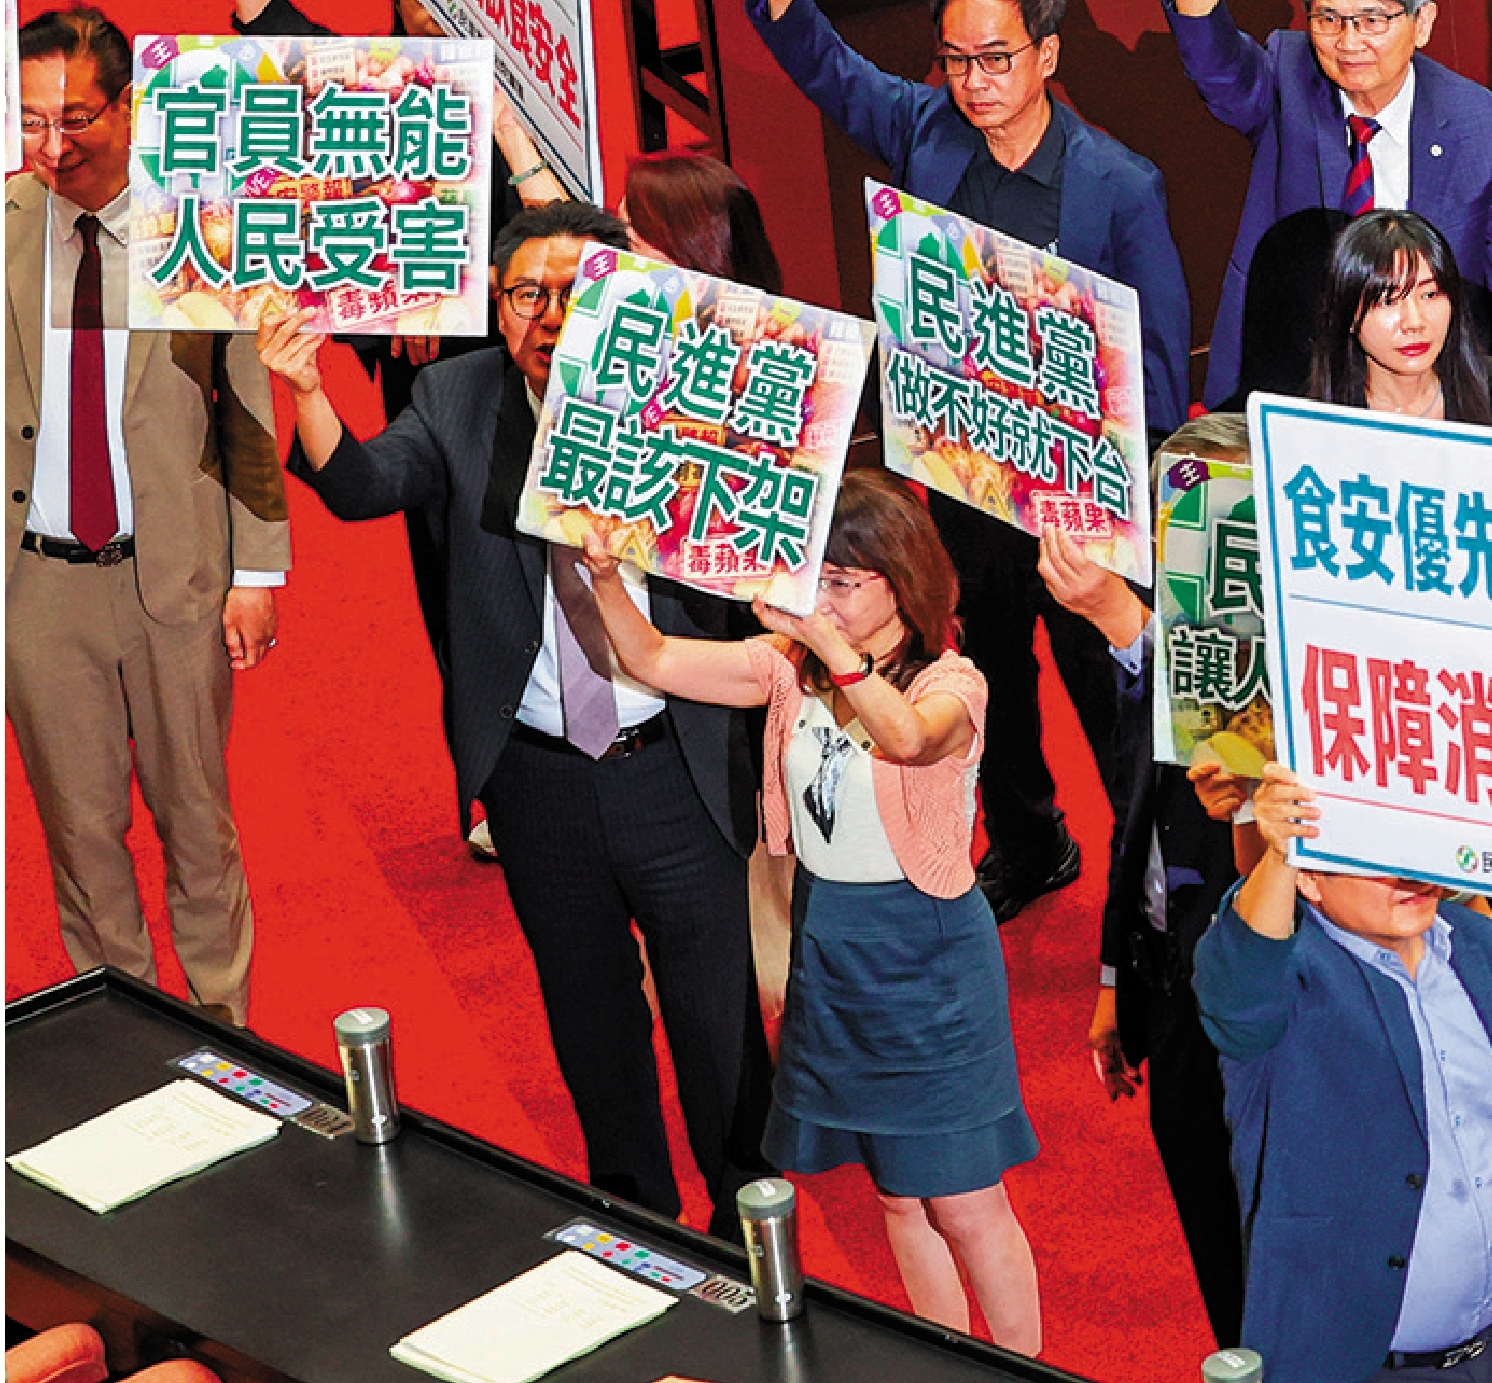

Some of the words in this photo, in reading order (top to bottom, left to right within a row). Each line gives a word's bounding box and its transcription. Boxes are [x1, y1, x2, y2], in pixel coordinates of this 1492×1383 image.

[155, 85, 469, 175] 官員無能
[151, 198, 467, 289] 人民受害
[338, 280, 439, 319] 毒蘋
[598, 304, 816, 446] 民進黨
[911, 255, 1101, 417] 民進黨
[541, 401, 818, 568] 最該下架
[889, 352, 1131, 518] 做不好就下台
